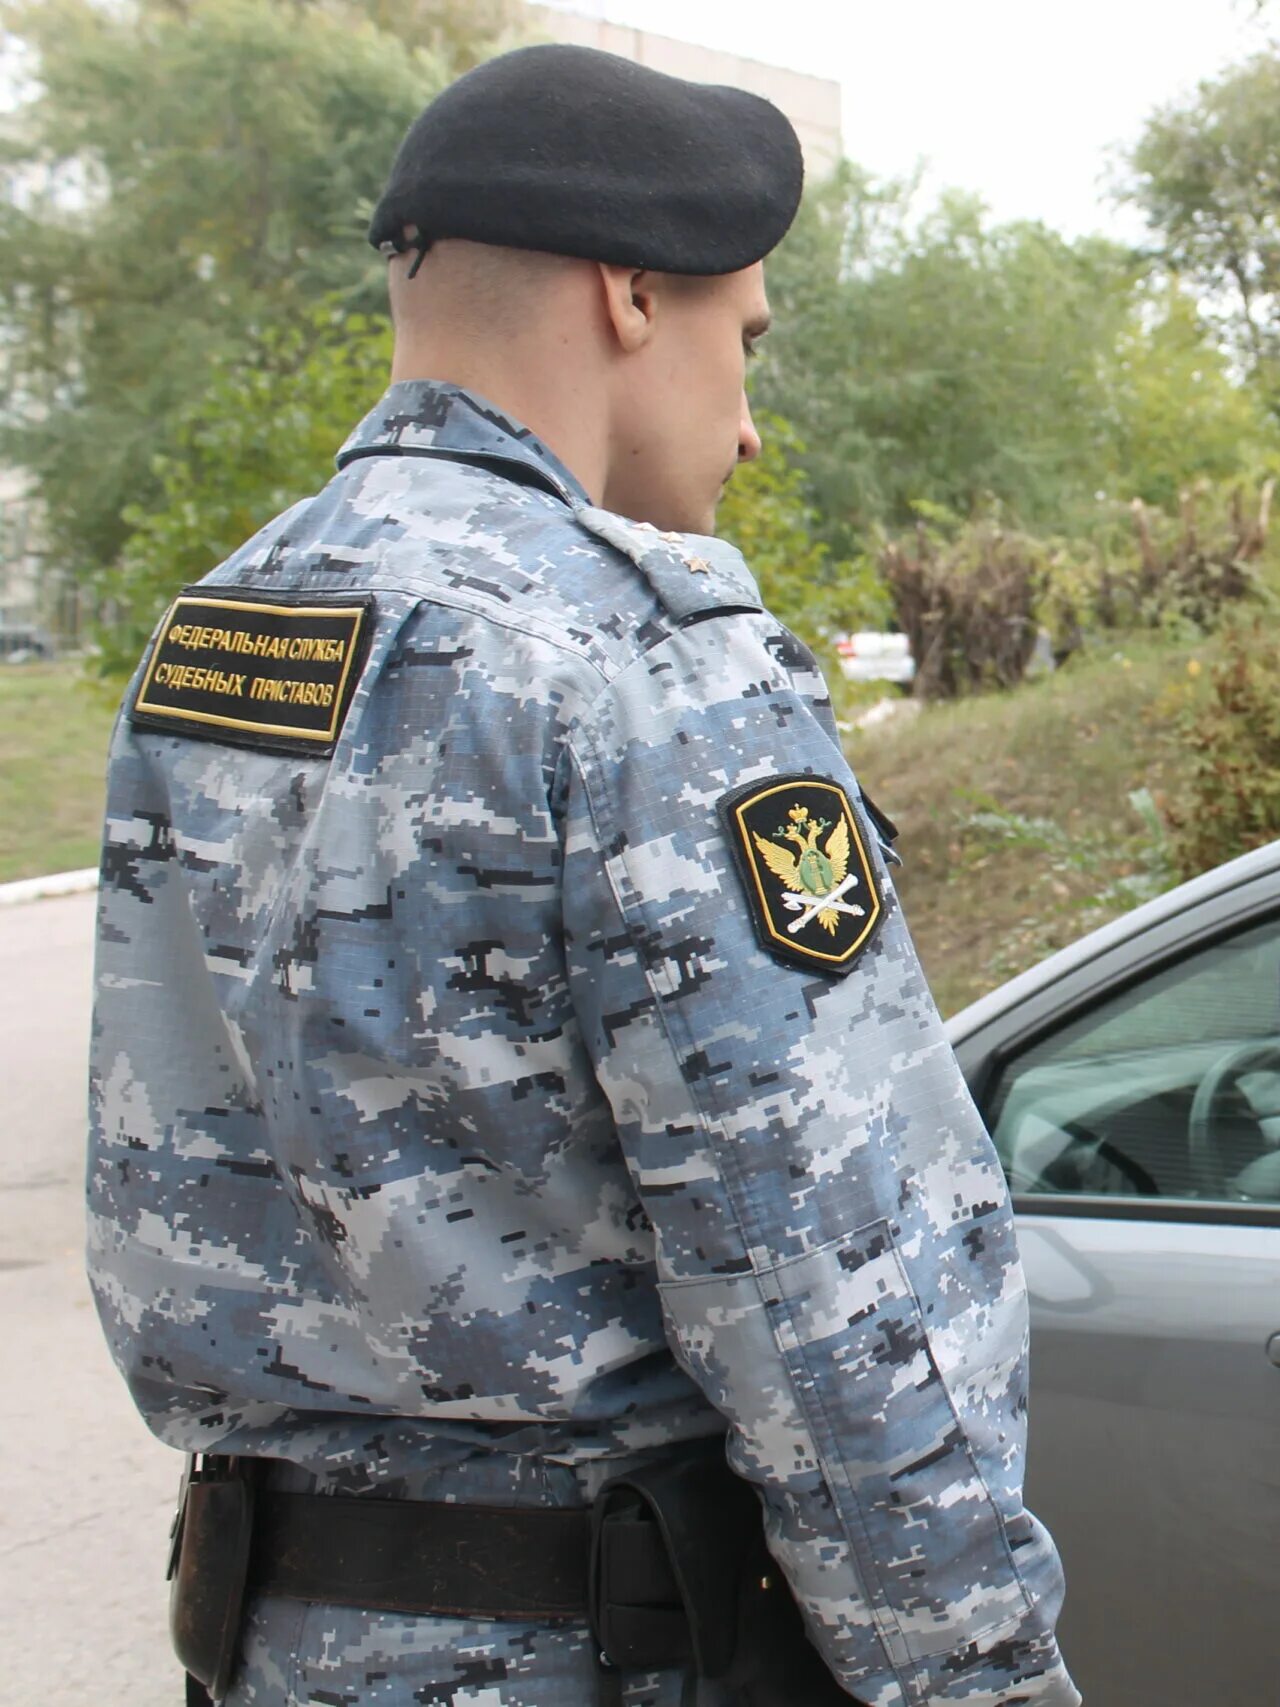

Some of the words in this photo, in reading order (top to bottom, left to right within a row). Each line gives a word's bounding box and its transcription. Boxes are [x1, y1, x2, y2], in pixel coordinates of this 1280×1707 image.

[168, 624, 290, 659] ФЕДЕРАЛЬНАЯ
[289, 637, 345, 662] СЛУЖБА
[155, 662, 247, 697] СУДЕБНЫХ
[249, 676, 334, 707] ПРИСТАВОВ
